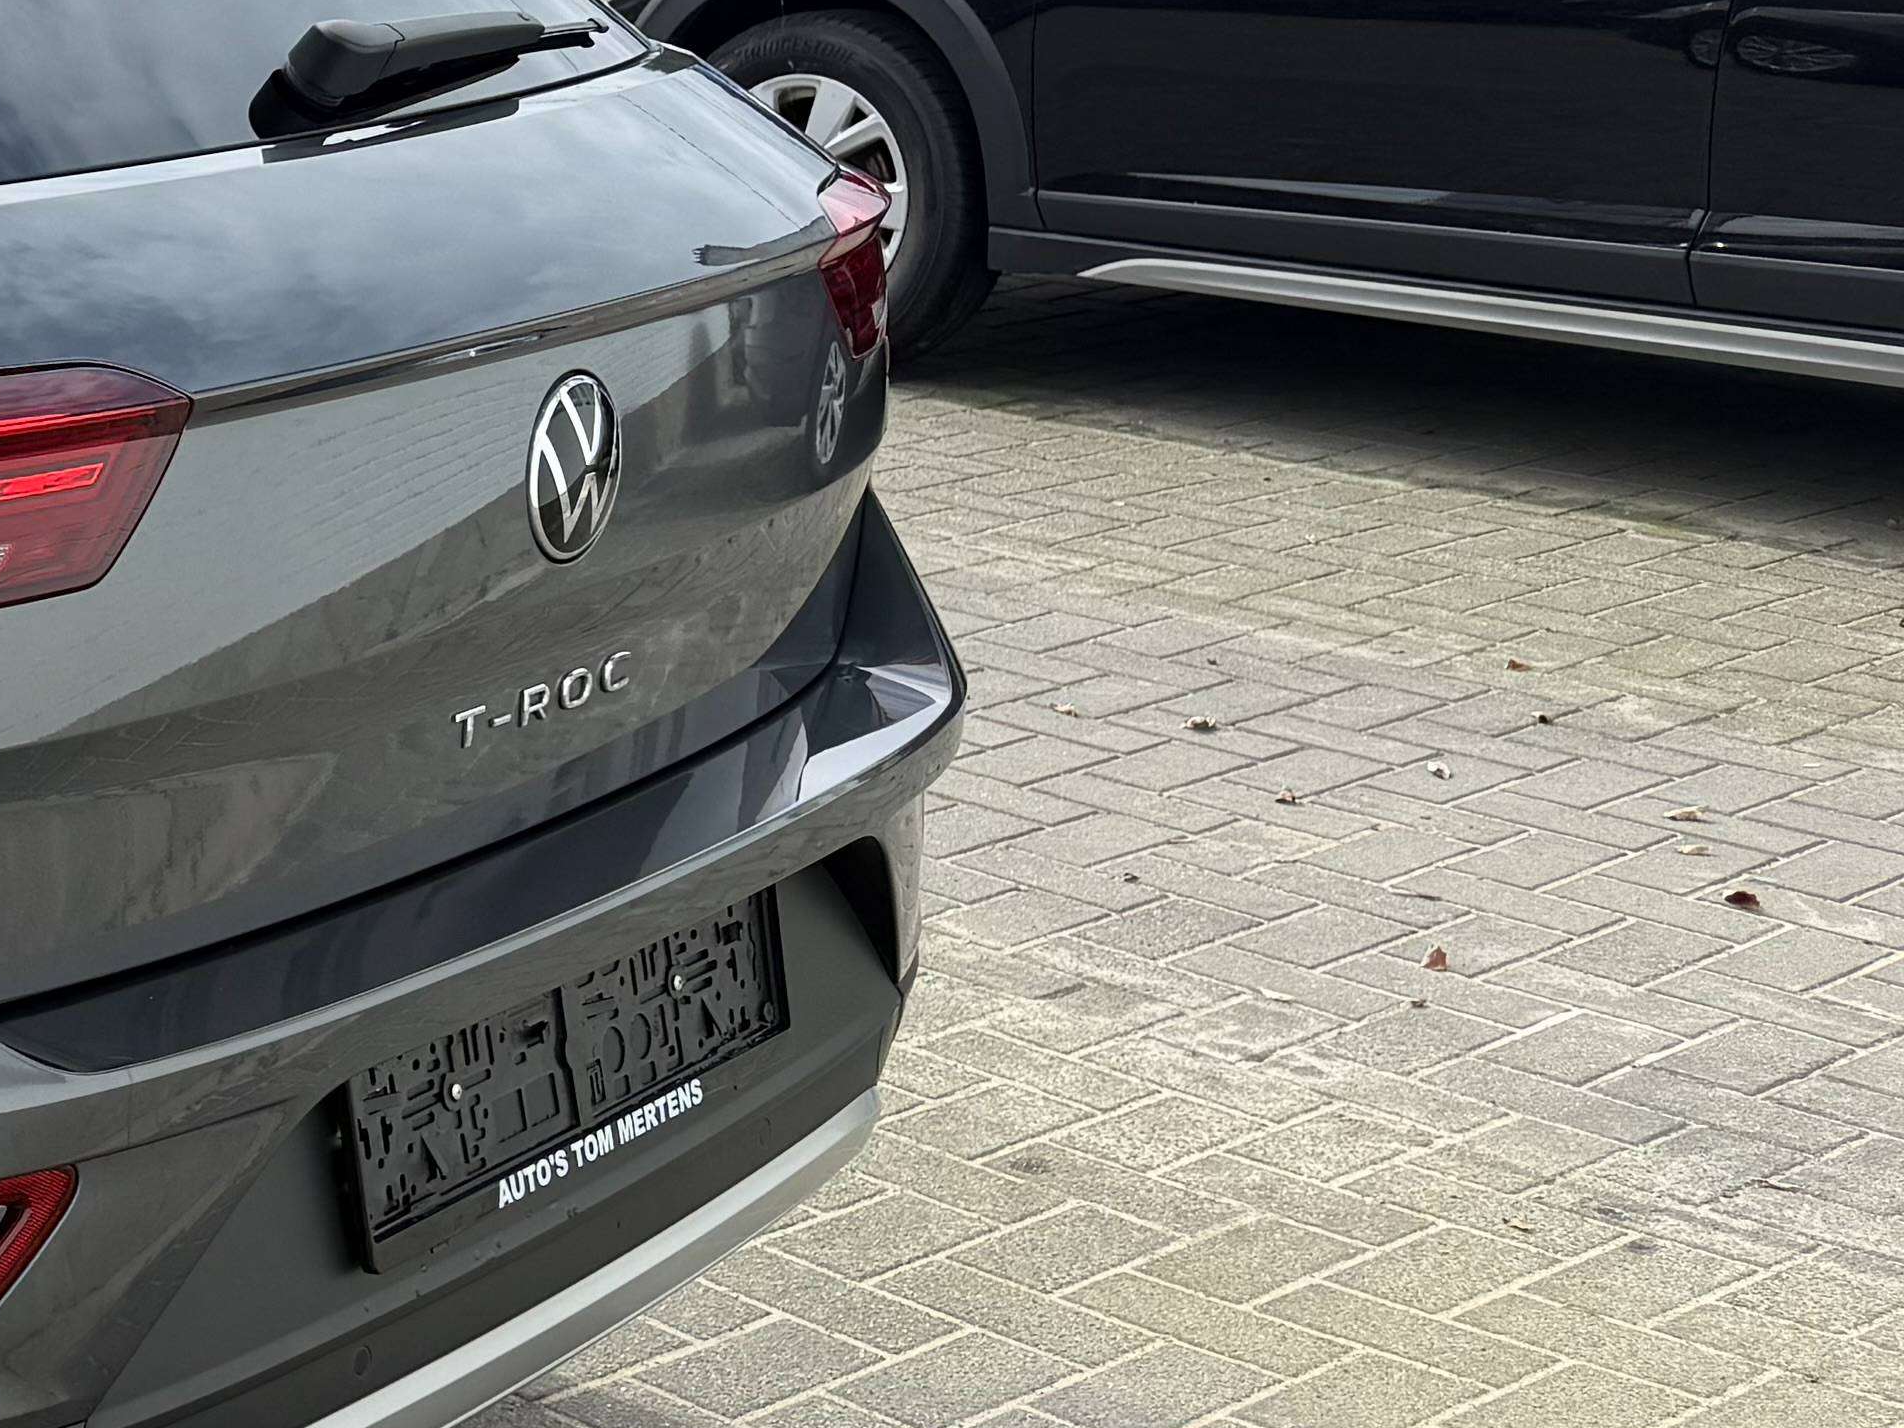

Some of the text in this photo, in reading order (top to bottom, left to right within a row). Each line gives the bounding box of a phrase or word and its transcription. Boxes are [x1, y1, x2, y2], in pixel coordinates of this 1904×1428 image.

[450, 650, 634, 749] T-ROC
[498, 1078, 704, 1209] AUTO'S TOM MERTENS
